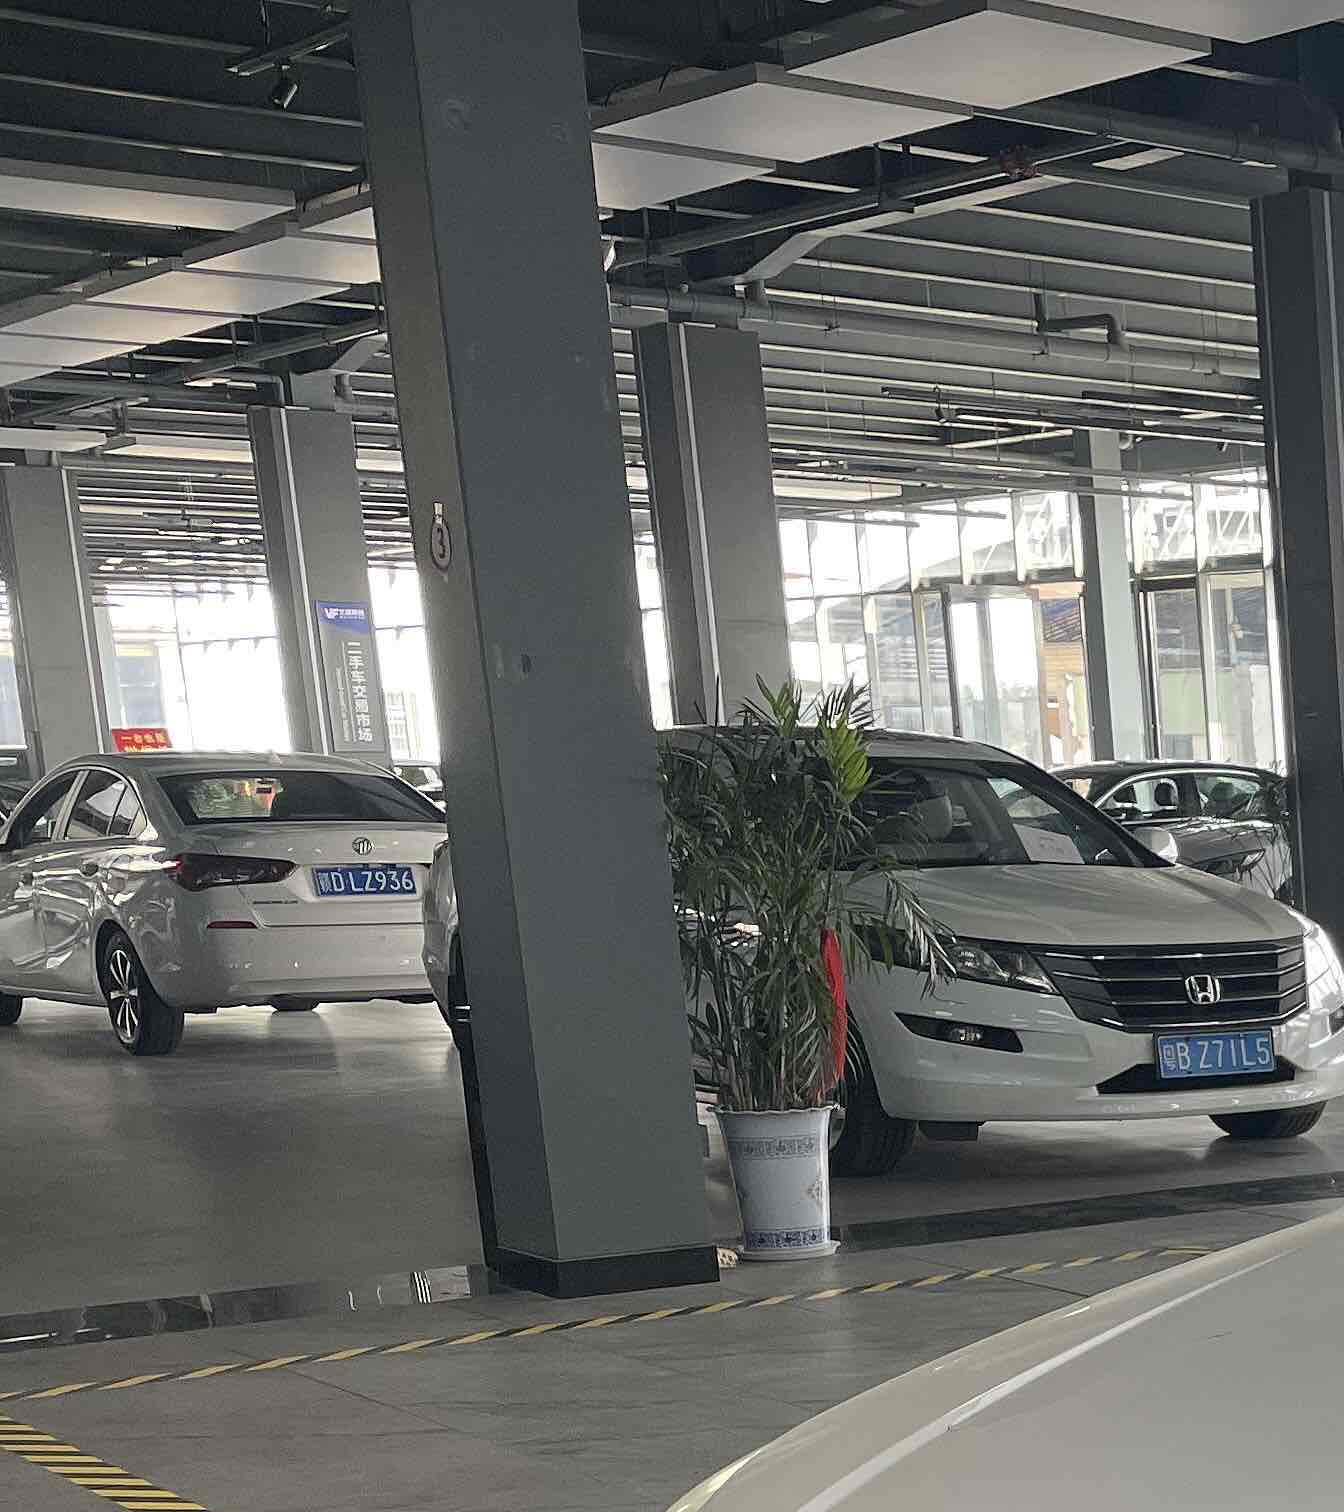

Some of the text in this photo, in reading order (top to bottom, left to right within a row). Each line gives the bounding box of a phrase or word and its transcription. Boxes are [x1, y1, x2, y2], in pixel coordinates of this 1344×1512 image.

[346, 641, 373, 742] 二手车交易市场
